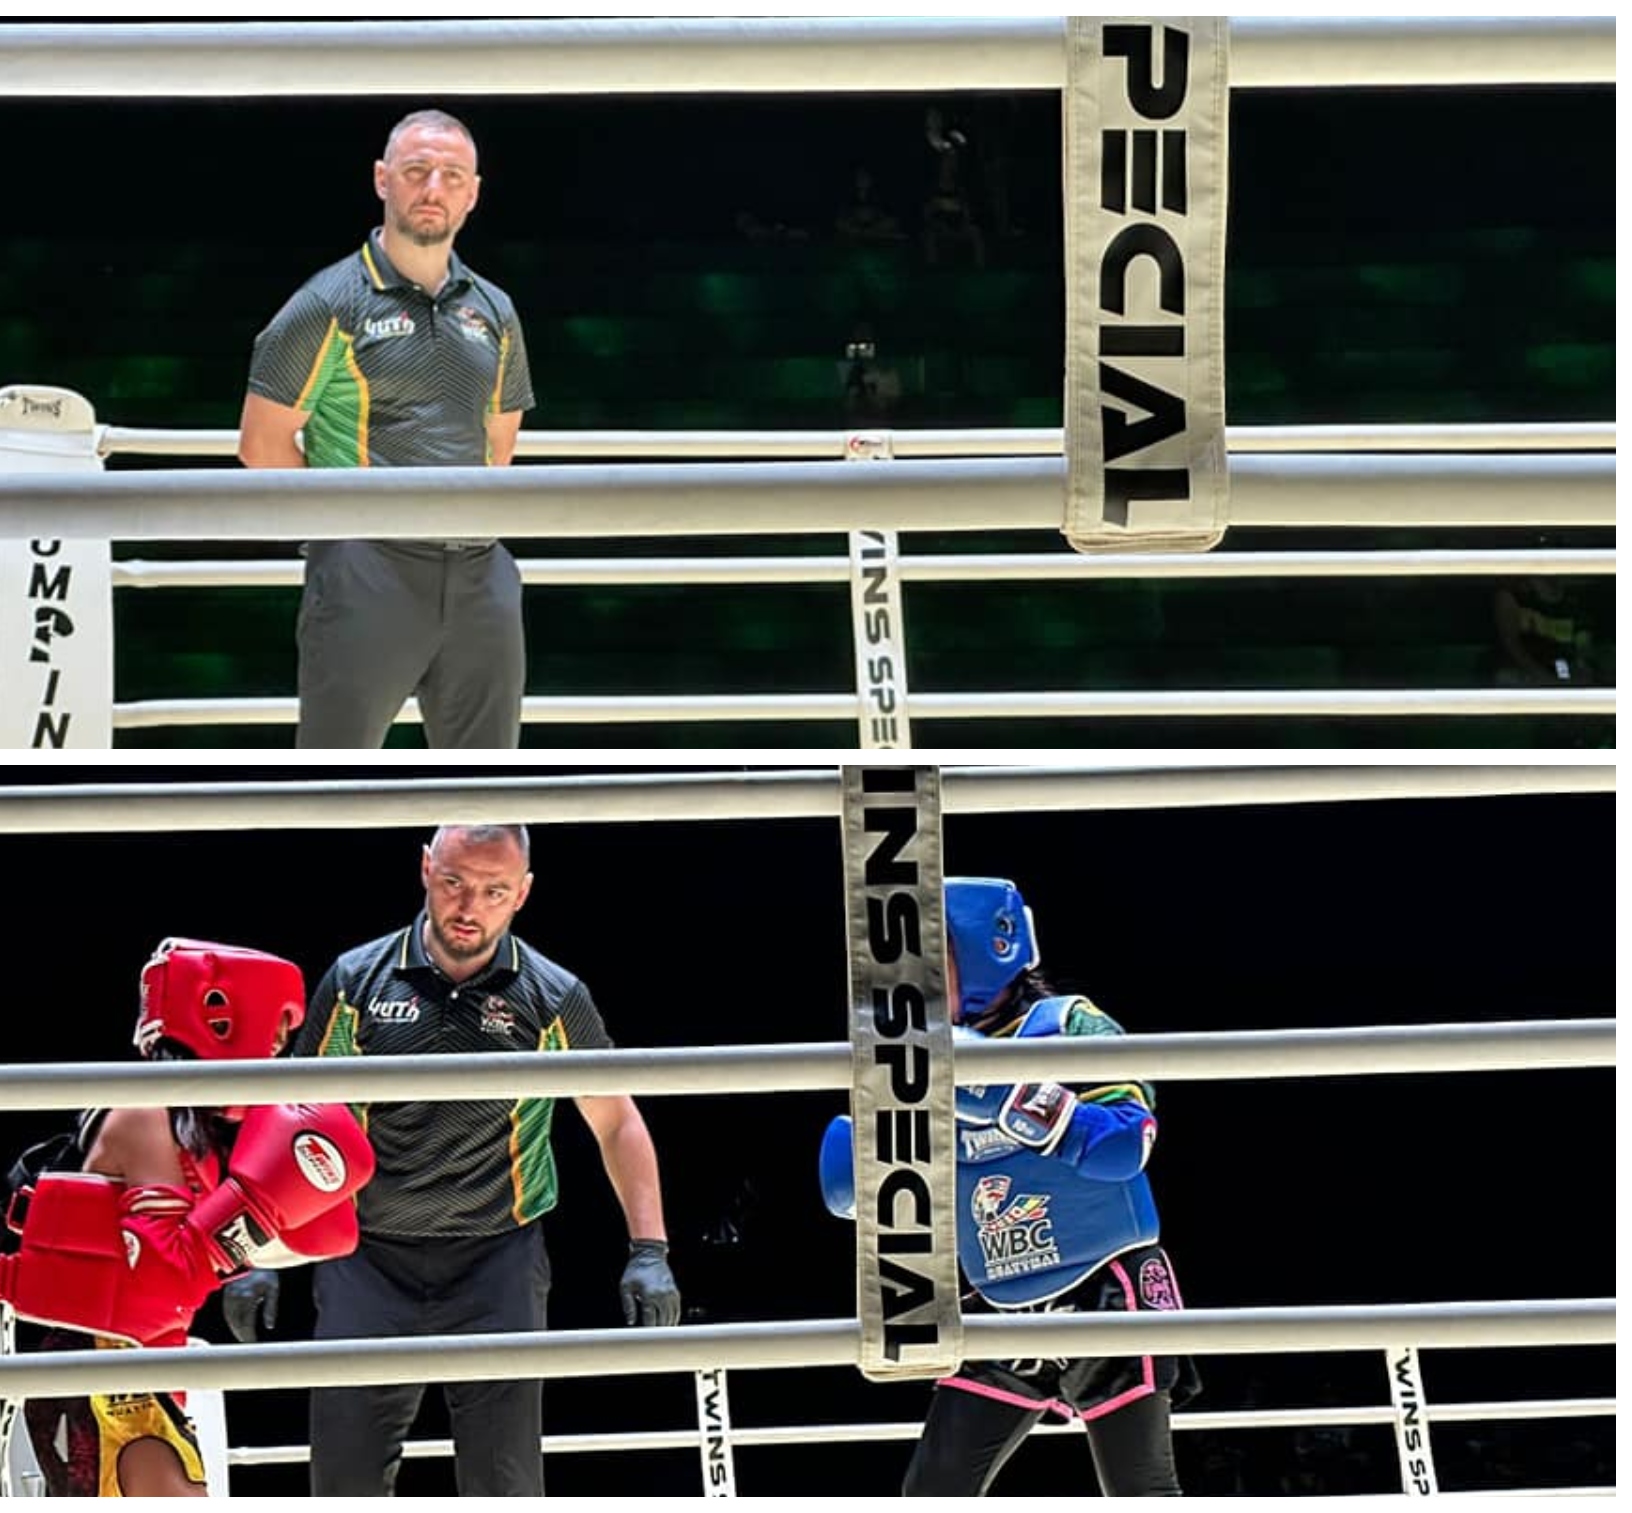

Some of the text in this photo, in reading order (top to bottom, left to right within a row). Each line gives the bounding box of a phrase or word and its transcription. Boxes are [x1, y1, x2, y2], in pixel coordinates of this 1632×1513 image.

[1099, 24, 1190, 528] PECIAL
[868, 656, 899, 749] SPE
[872, 983, 939, 1362] SPECIAL
[979, 1219, 1054, 1261] WBC
[702, 1368, 727, 1487] TWINS
[1395, 1348, 1422, 1452] WINS
